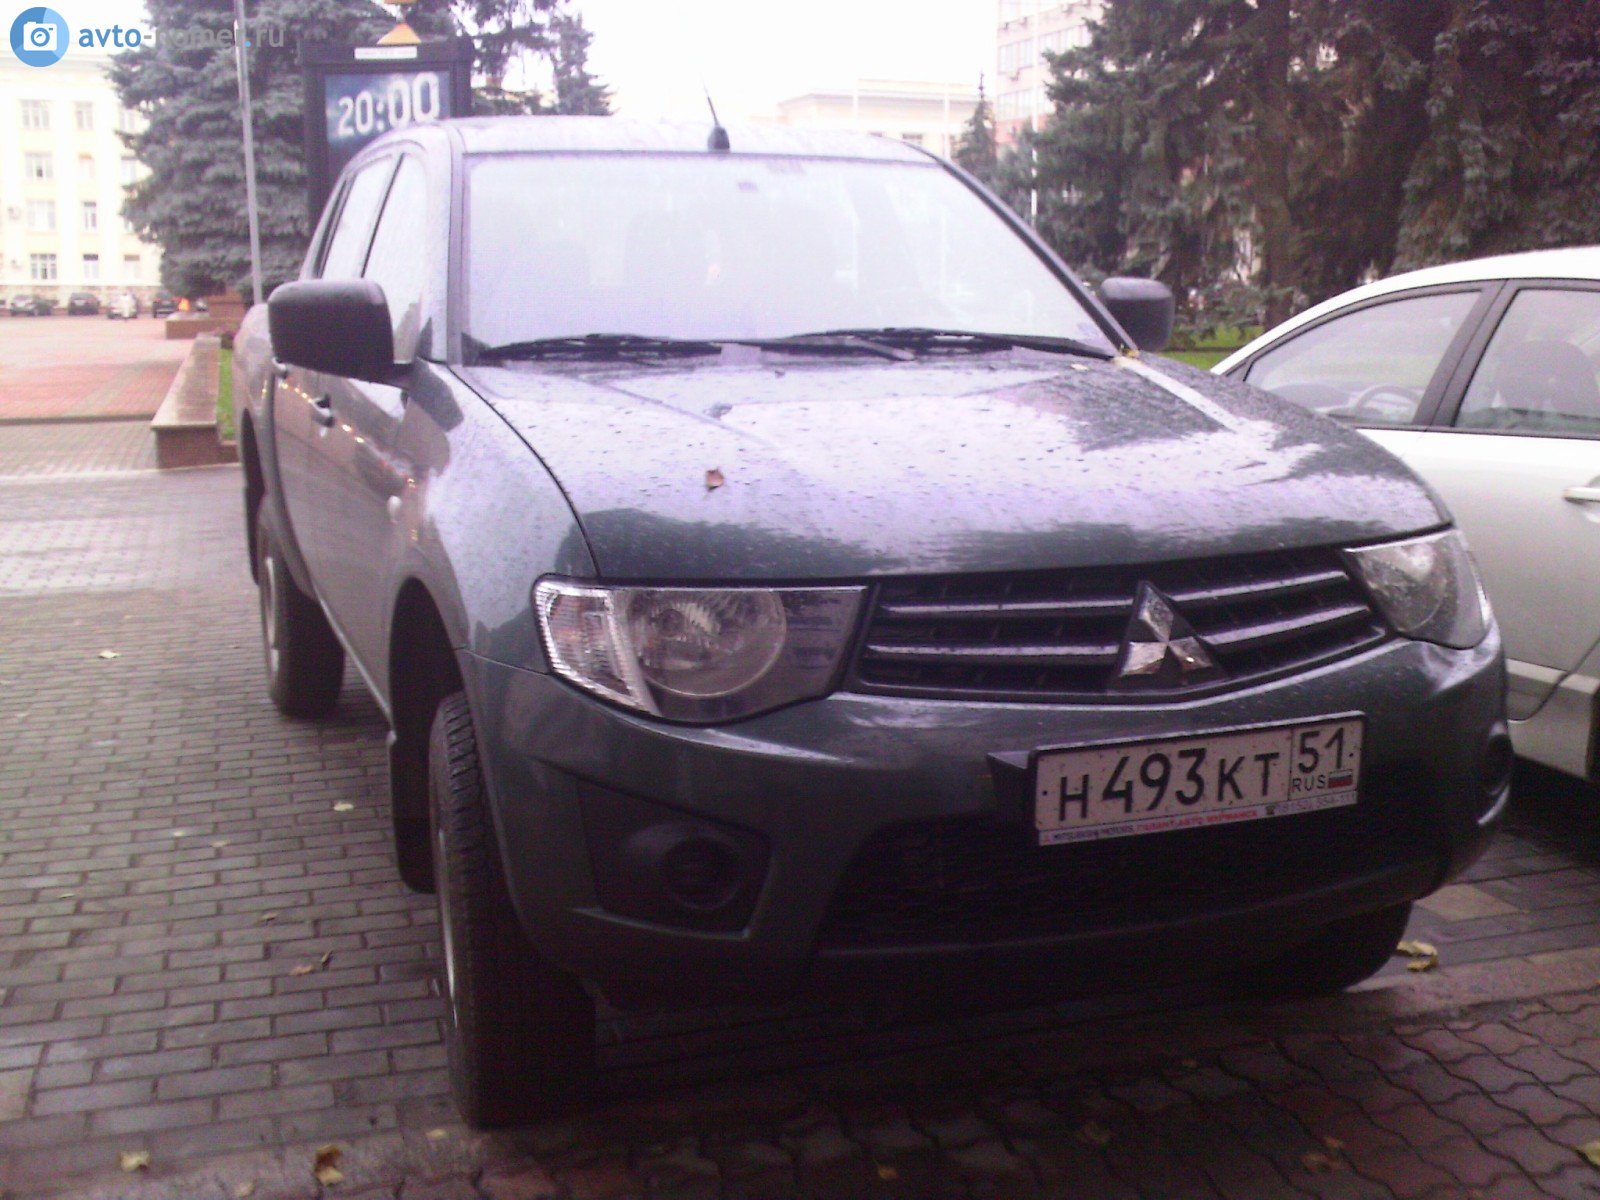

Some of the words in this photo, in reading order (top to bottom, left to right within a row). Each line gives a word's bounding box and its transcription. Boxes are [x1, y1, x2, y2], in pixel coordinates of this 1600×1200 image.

[337, 71, 440, 137] 20:00
[1298, 727, 1345, 774] 51
[1291, 774, 1326, 793] RUS
